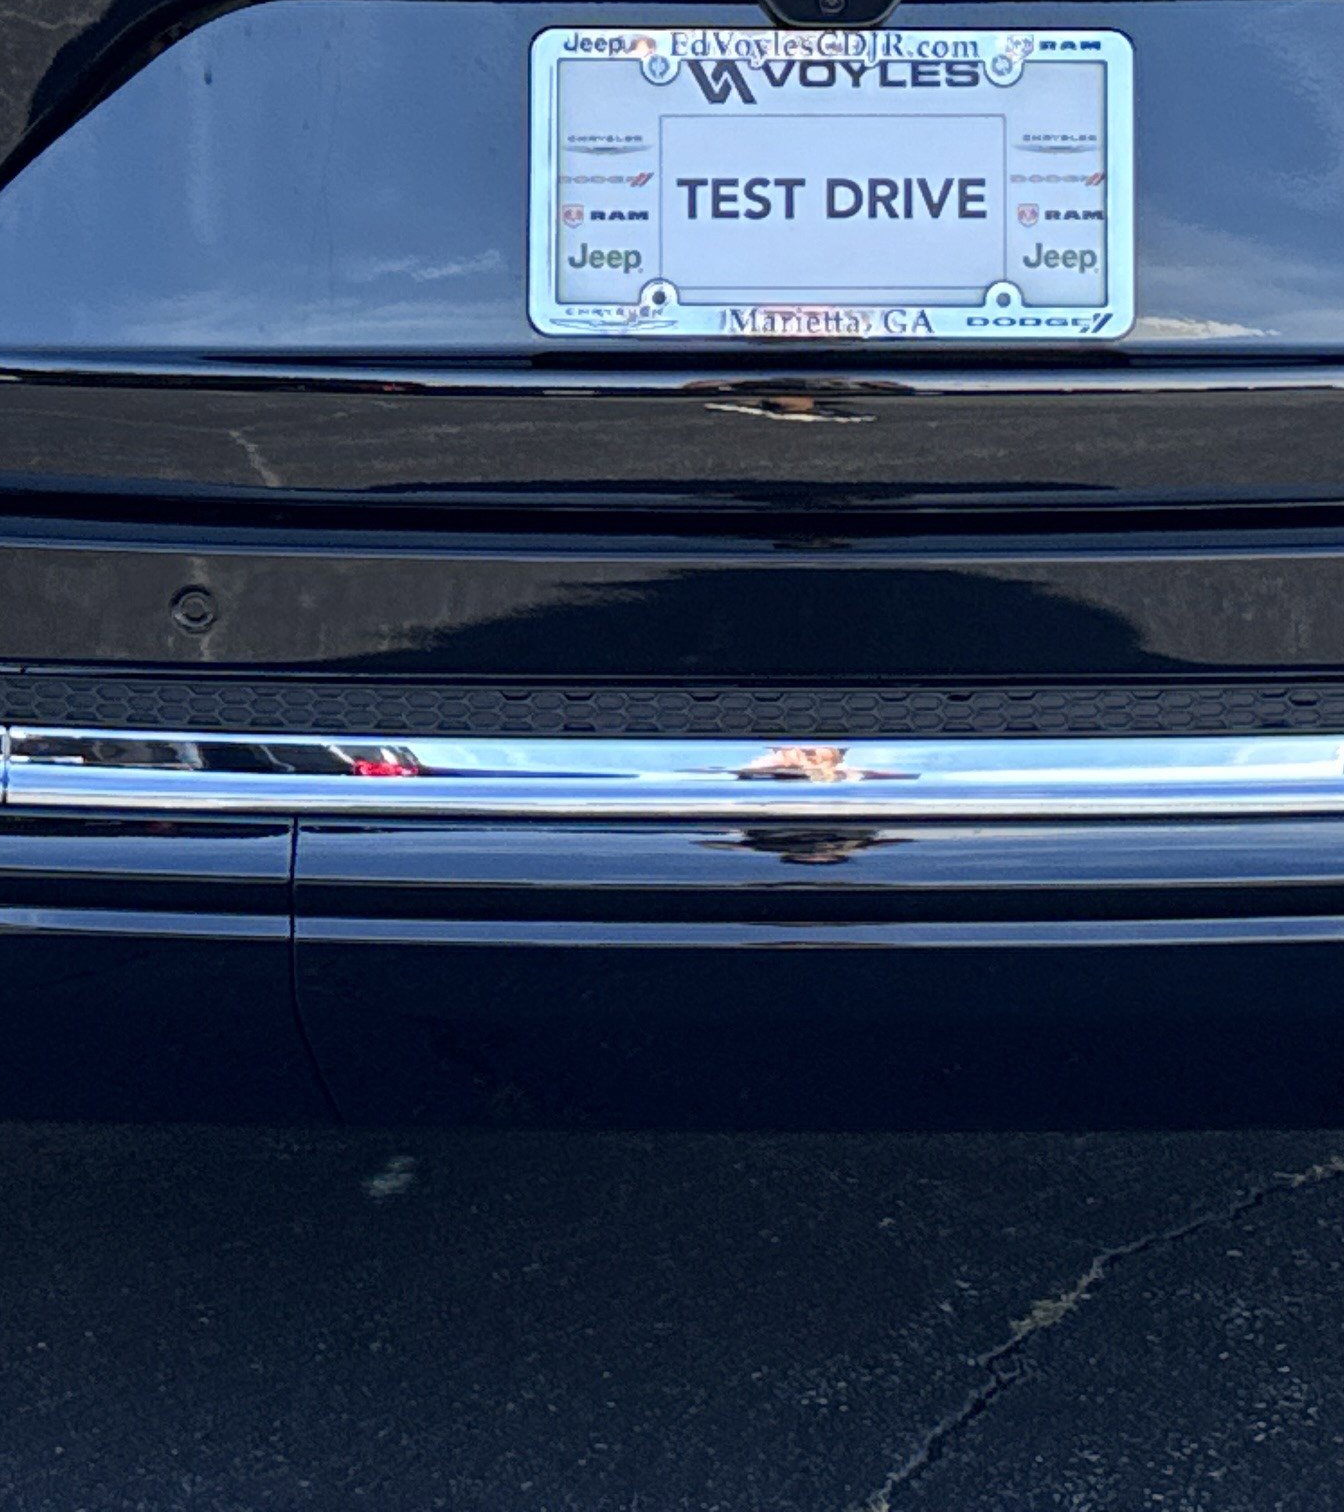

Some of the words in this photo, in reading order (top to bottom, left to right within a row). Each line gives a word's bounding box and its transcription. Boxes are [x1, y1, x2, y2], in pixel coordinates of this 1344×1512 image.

[563, 31, 623, 56] Jeep
[669, 30, 980, 65] EdVoylesCDJR.com
[1038, 39, 1102, 51] RAM
[761, 60, 980, 89] VOYLES
[675, 177, 807, 221] TEST
[825, 177, 988, 220] DRIVE
[589, 209, 650, 221] RAM
[1043, 209, 1105, 221] RAM
[567, 242, 642, 274] Jeep
[1022, 242, 1098, 274] Jeep
[883, 308, 935, 334] GA
